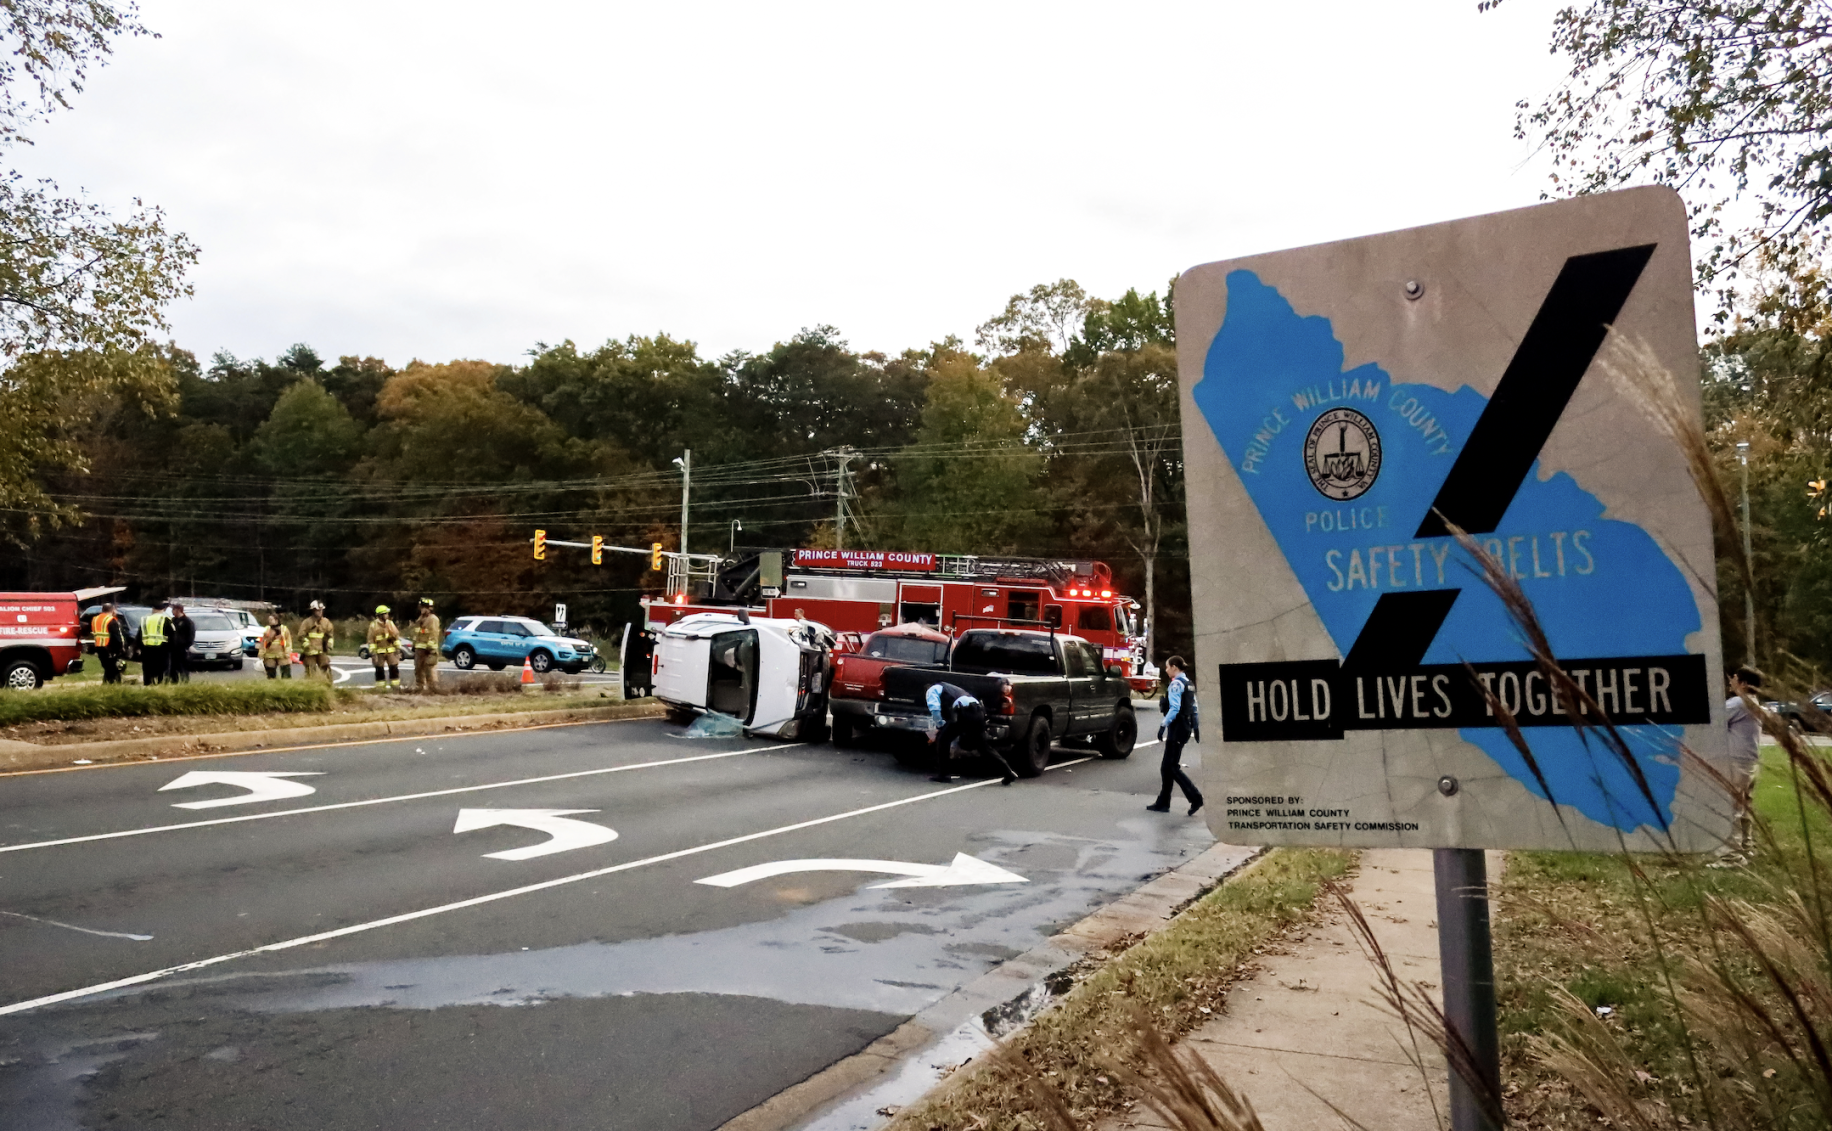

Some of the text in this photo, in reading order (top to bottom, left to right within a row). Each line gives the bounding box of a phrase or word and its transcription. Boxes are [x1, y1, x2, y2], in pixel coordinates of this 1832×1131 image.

[1241, 378, 1453, 475] PRINCE WILLIAM COUNTY
[1313, 413, 1339, 436] PRINCE
[1343, 411, 1376, 440] WILLIAM
[1309, 438, 1316, 449] OF
[1307, 455, 1316, 474] SEAL
[1366, 442, 1379, 480] COUNTY
[1315, 477, 1329, 492] THE
[1305, 506, 1389, 533] POLICE
[798, 550, 932, 565] PRINCE WILLIAM COUNTY
[1326, 543, 1449, 592] SAFETY
[1246, 667, 1673, 723] HOLD LIVES TOGETHER
[1226, 796, 1304, 805] SPONSORED BY:
[1227, 809, 1350, 817] PRINCE WILLIAM COUNTY
[1228, 822, 1419, 831] TRANSPORTATION SAFETY COMMISSION
